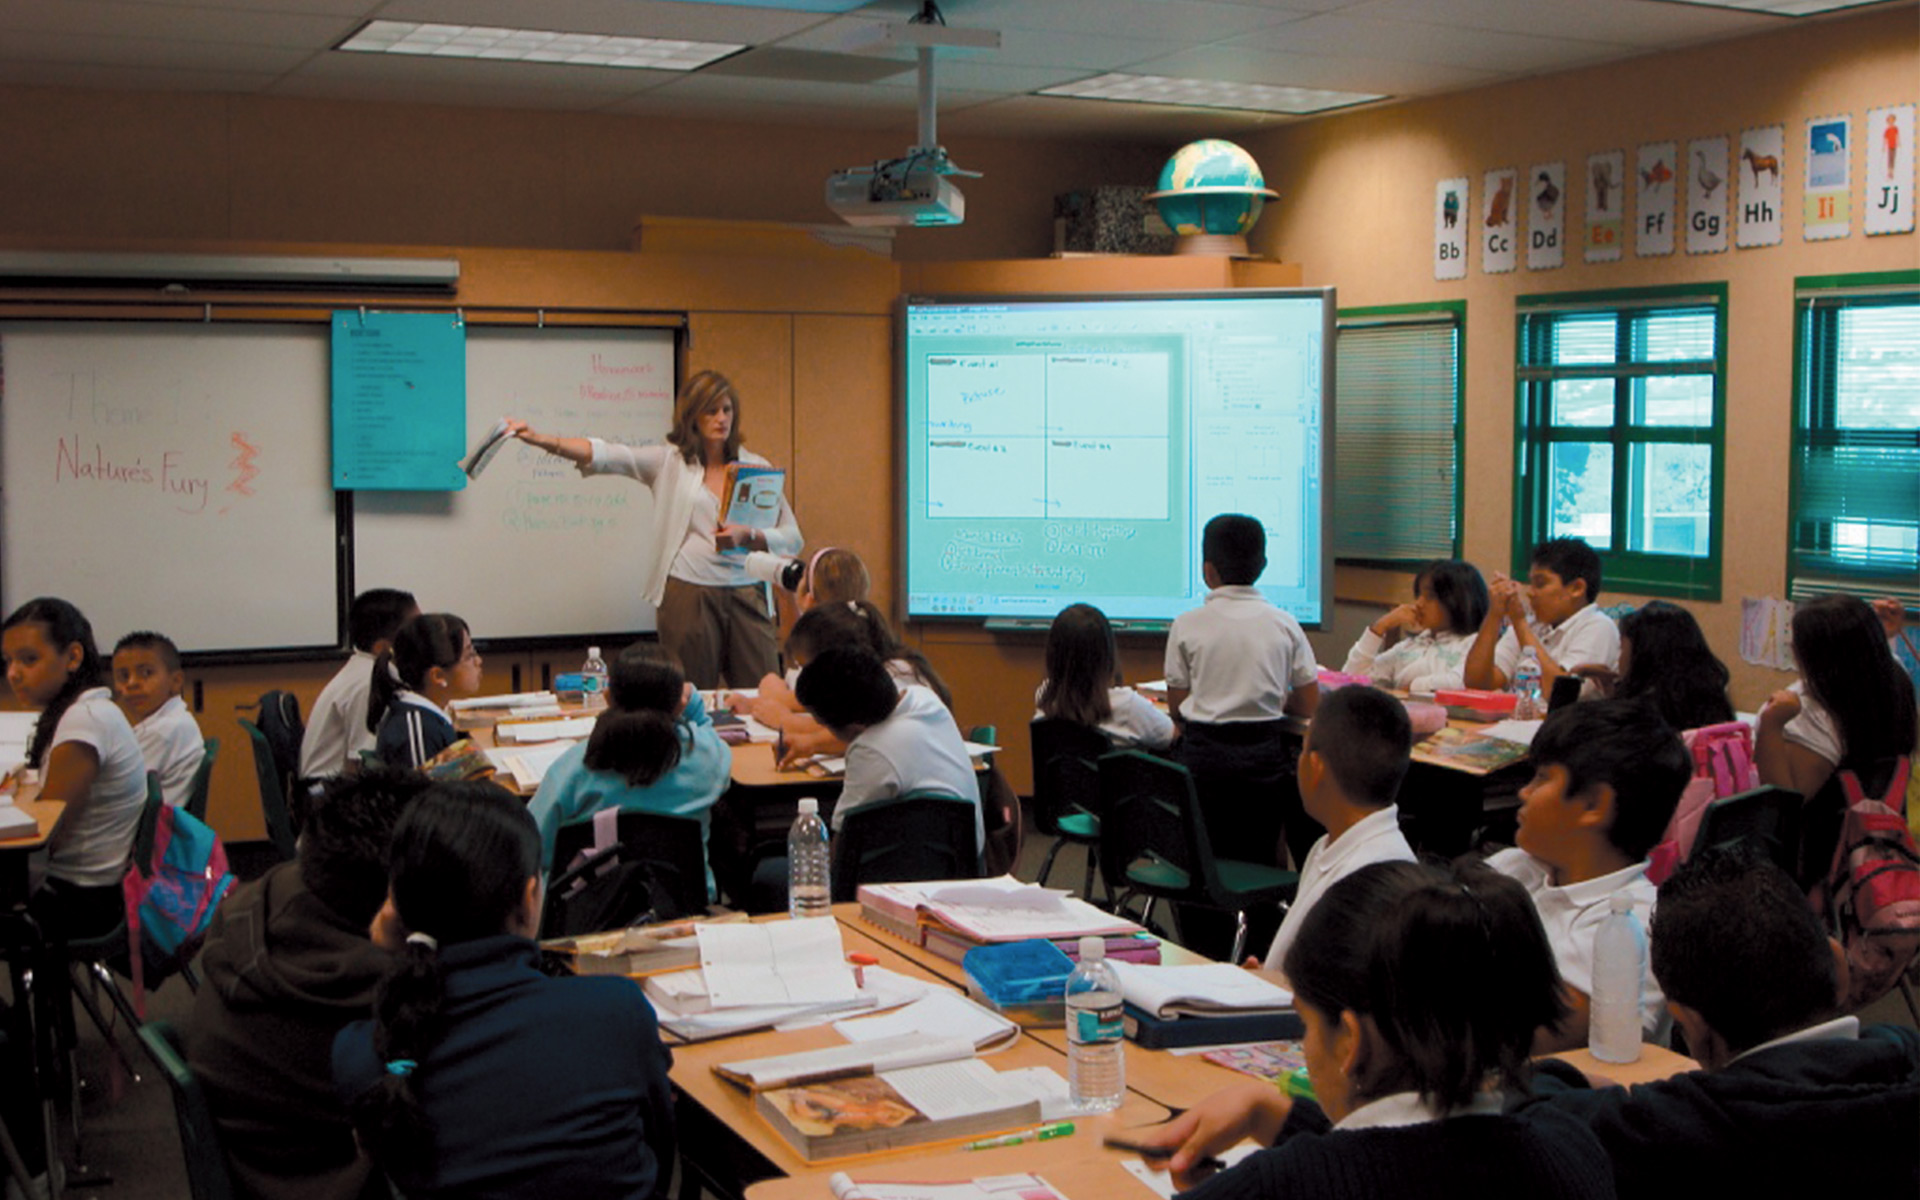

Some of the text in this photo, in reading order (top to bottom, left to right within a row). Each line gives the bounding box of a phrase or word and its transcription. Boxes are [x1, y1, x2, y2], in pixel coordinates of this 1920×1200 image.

[1817, 197, 1835, 220] Ii
[1878, 186, 1899, 214] Jj
[1645, 212, 1665, 234] Ff
[1692, 211, 1720, 236] Gg
[1744, 201, 1773, 224] Hh
[1488, 234, 1509, 253] Cc
[1532, 228, 1557, 249] Dd
[1591, 226, 1614, 244] Ee
[1439, 242, 1460, 260] Bb
[56, 433, 209, 514] Nature's Fury
